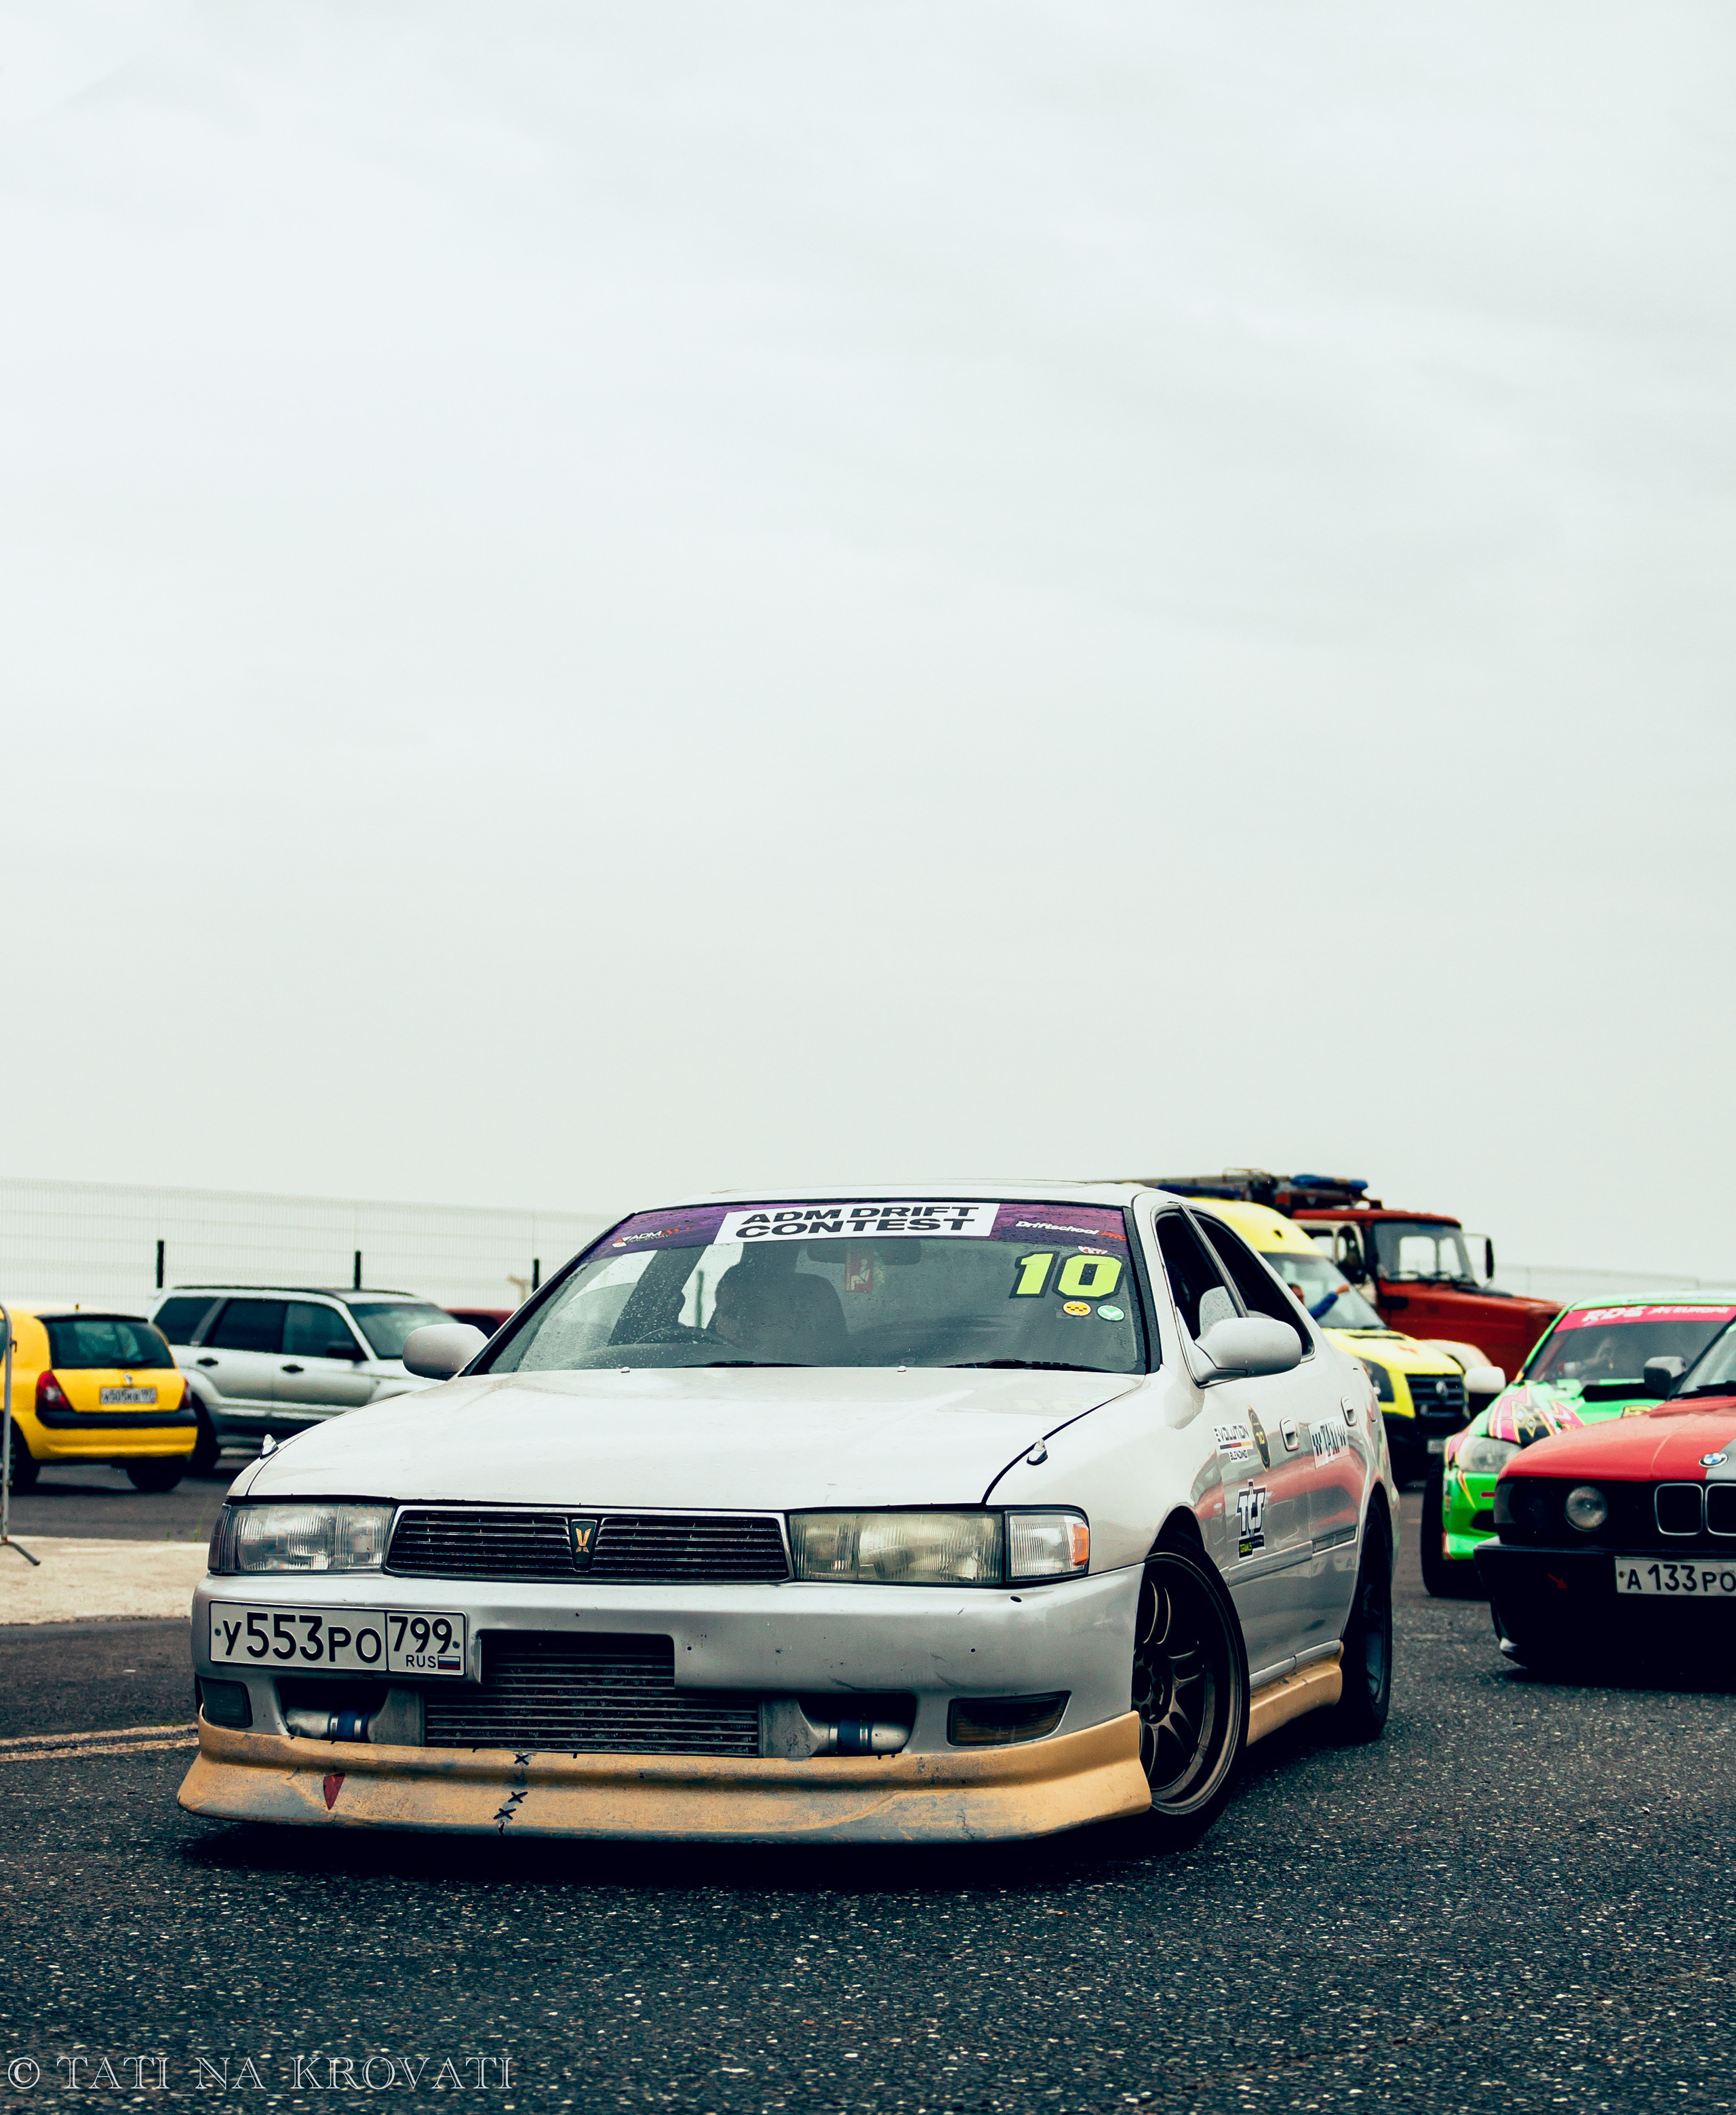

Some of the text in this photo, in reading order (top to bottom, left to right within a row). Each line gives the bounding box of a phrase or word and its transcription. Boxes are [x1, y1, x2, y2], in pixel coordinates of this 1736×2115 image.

[741, 1206, 980, 1225] ADM DRIFT
[628, 1230, 663, 1241] ADM
[735, 1218, 975, 1239] CONTEST
[1012, 1251, 1124, 1300] 10
[1214, 1424, 1250, 1442] EVOLUTION
[389, 1615, 452, 1654] 799
[406, 1654, 437, 1668] RUS
